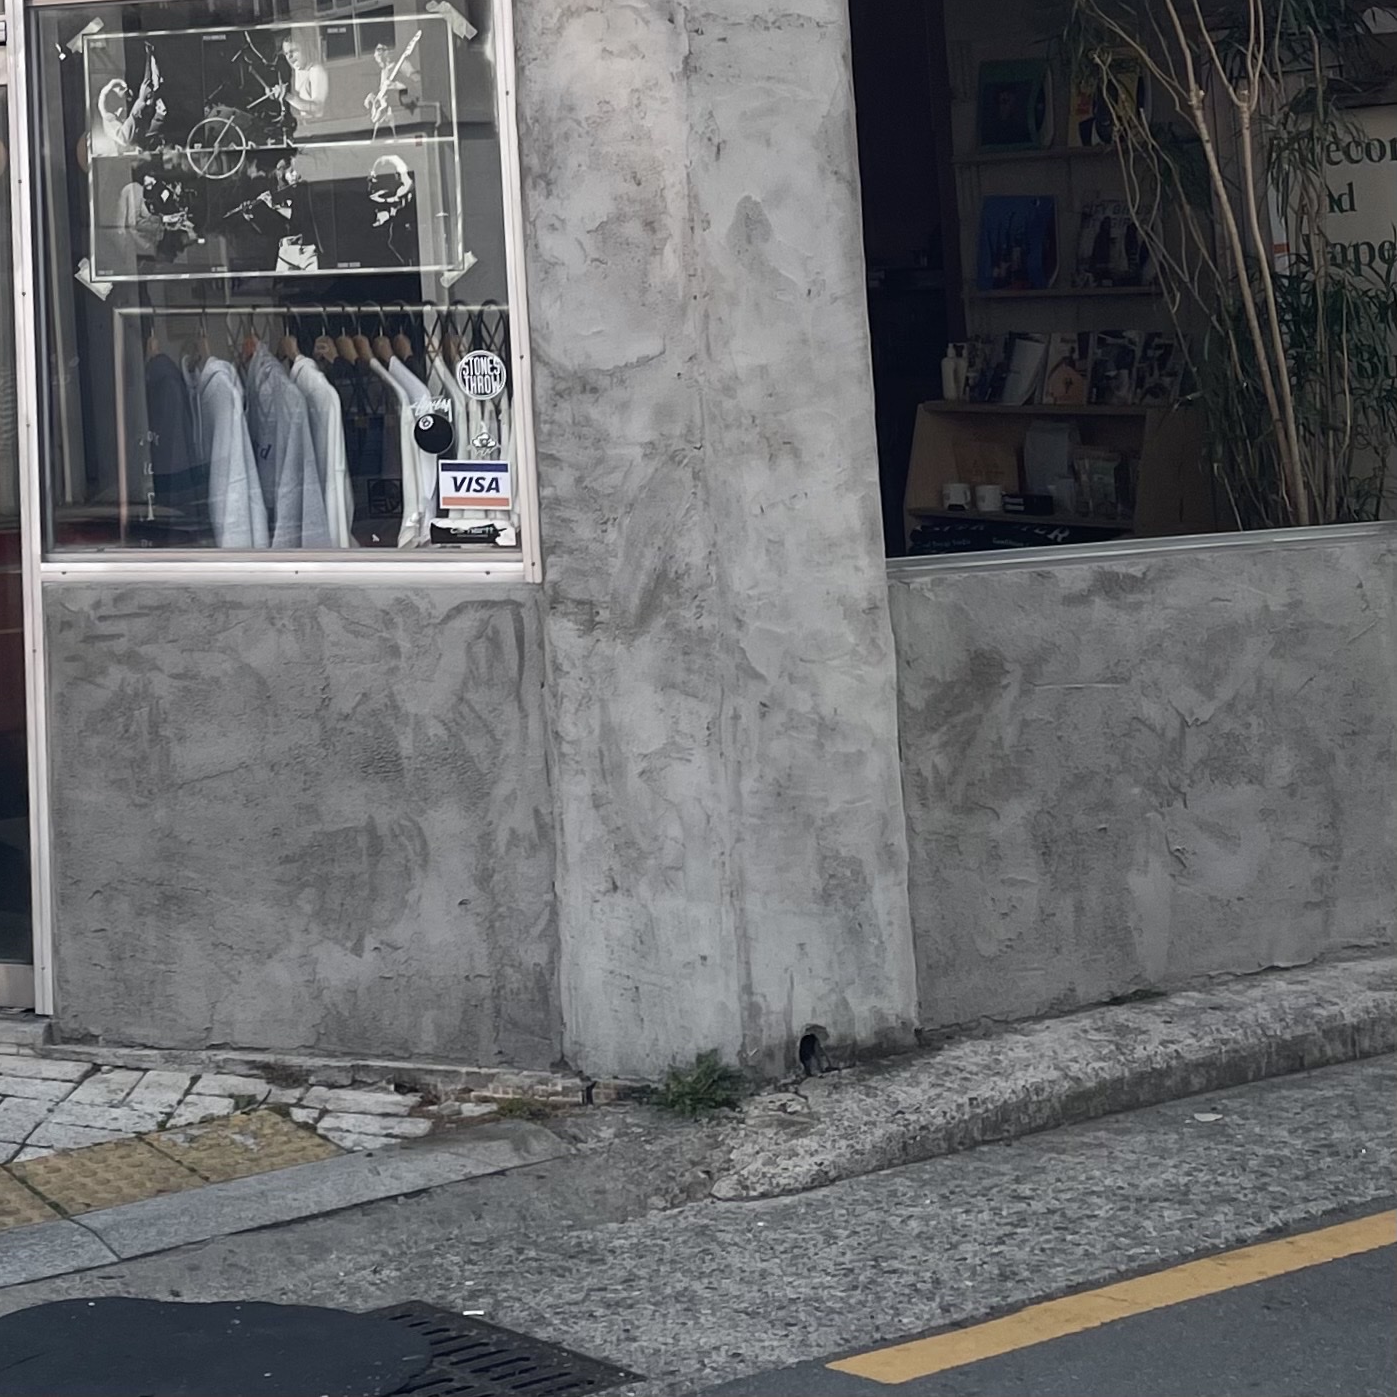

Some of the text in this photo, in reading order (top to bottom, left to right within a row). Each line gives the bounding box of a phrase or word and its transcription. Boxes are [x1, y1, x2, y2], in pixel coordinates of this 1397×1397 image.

[463, 357, 501, 376] STONES
[464, 375, 501, 395] THROW
[451, 476, 501, 493] VISA
